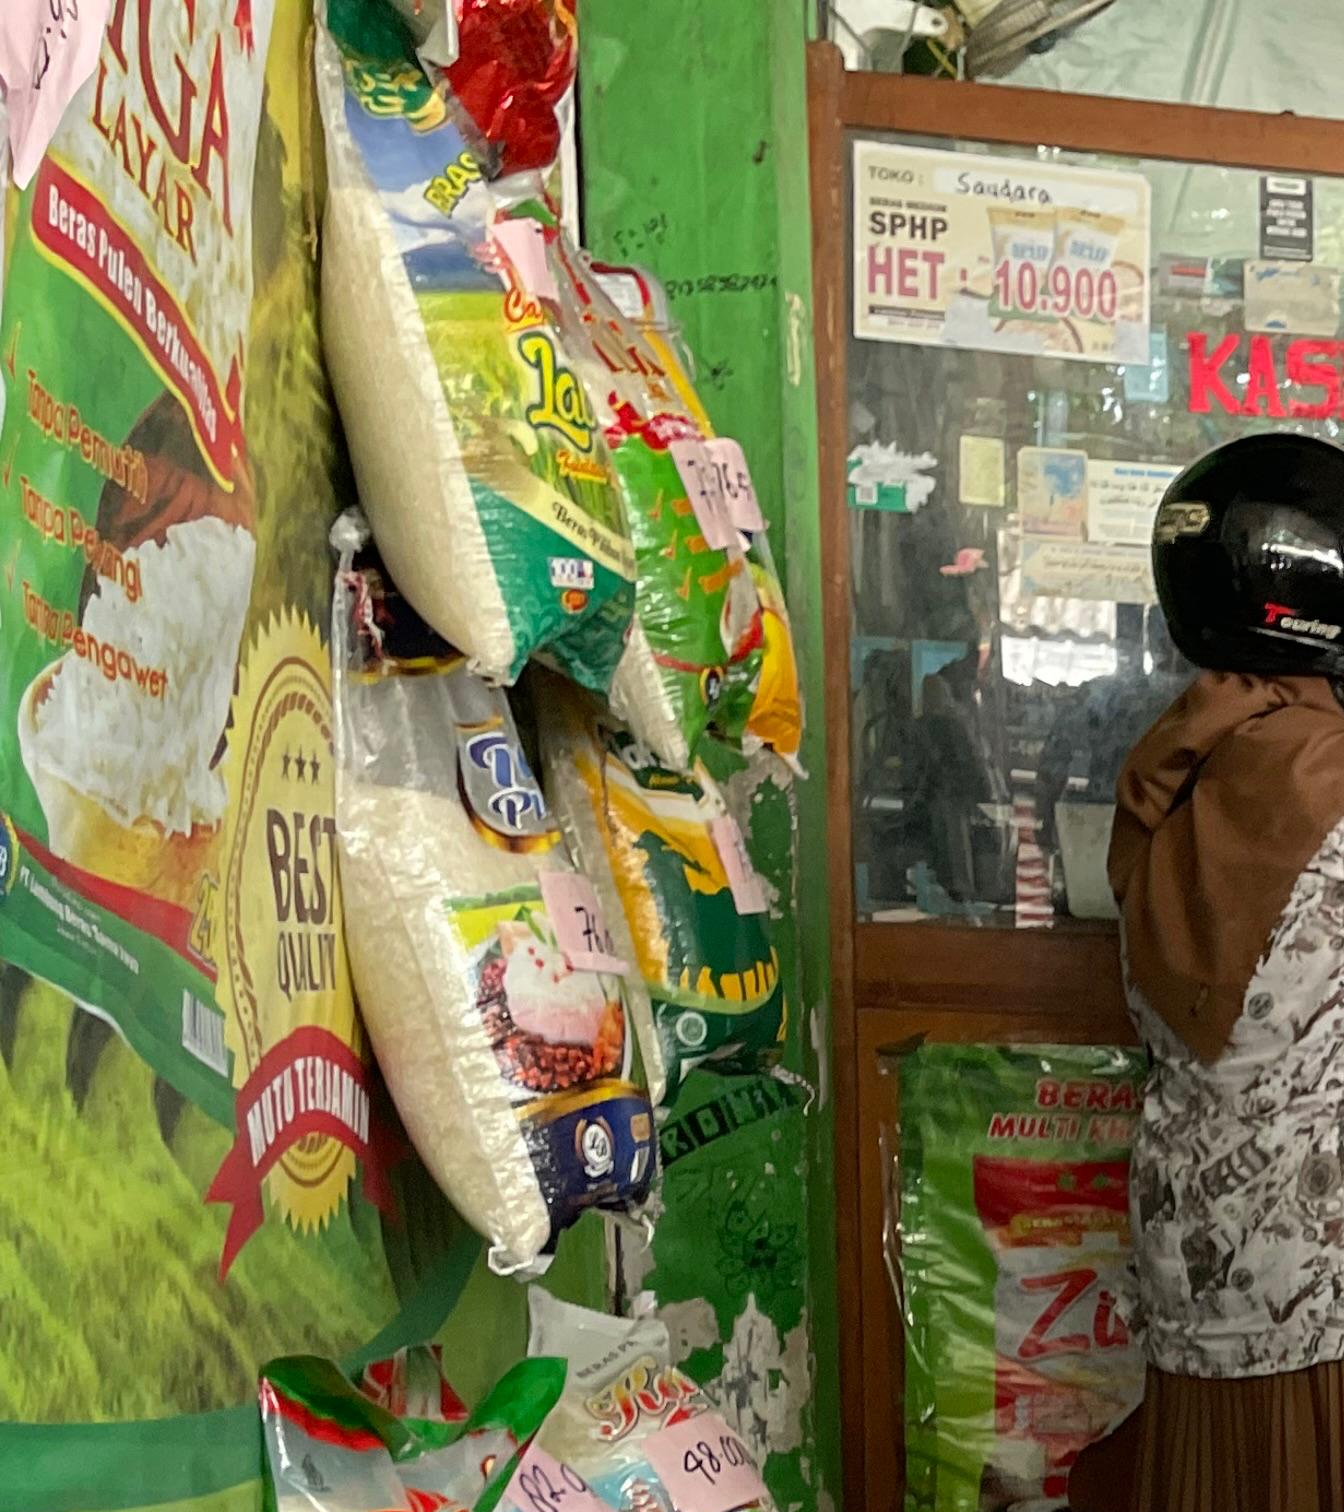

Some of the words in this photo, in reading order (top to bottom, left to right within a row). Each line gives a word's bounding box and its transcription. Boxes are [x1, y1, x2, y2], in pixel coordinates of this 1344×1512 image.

[92, 57, 197, 267] LAYAR
[955, 171, 1053, 206] Saudara
[48, 183, 96, 259] Beras
[99, 228, 142, 315] Pulen
[868, 211, 949, 241] SPHP
[867, 244, 945, 301] HET
[994, 259, 1119, 320] 10.900
[63, 611, 168, 701] Pengawet
[266, 807, 338, 926] BEST
[246, 1065, 296, 1168] MUTU
[987, 1112, 1081, 1142] MULTI
